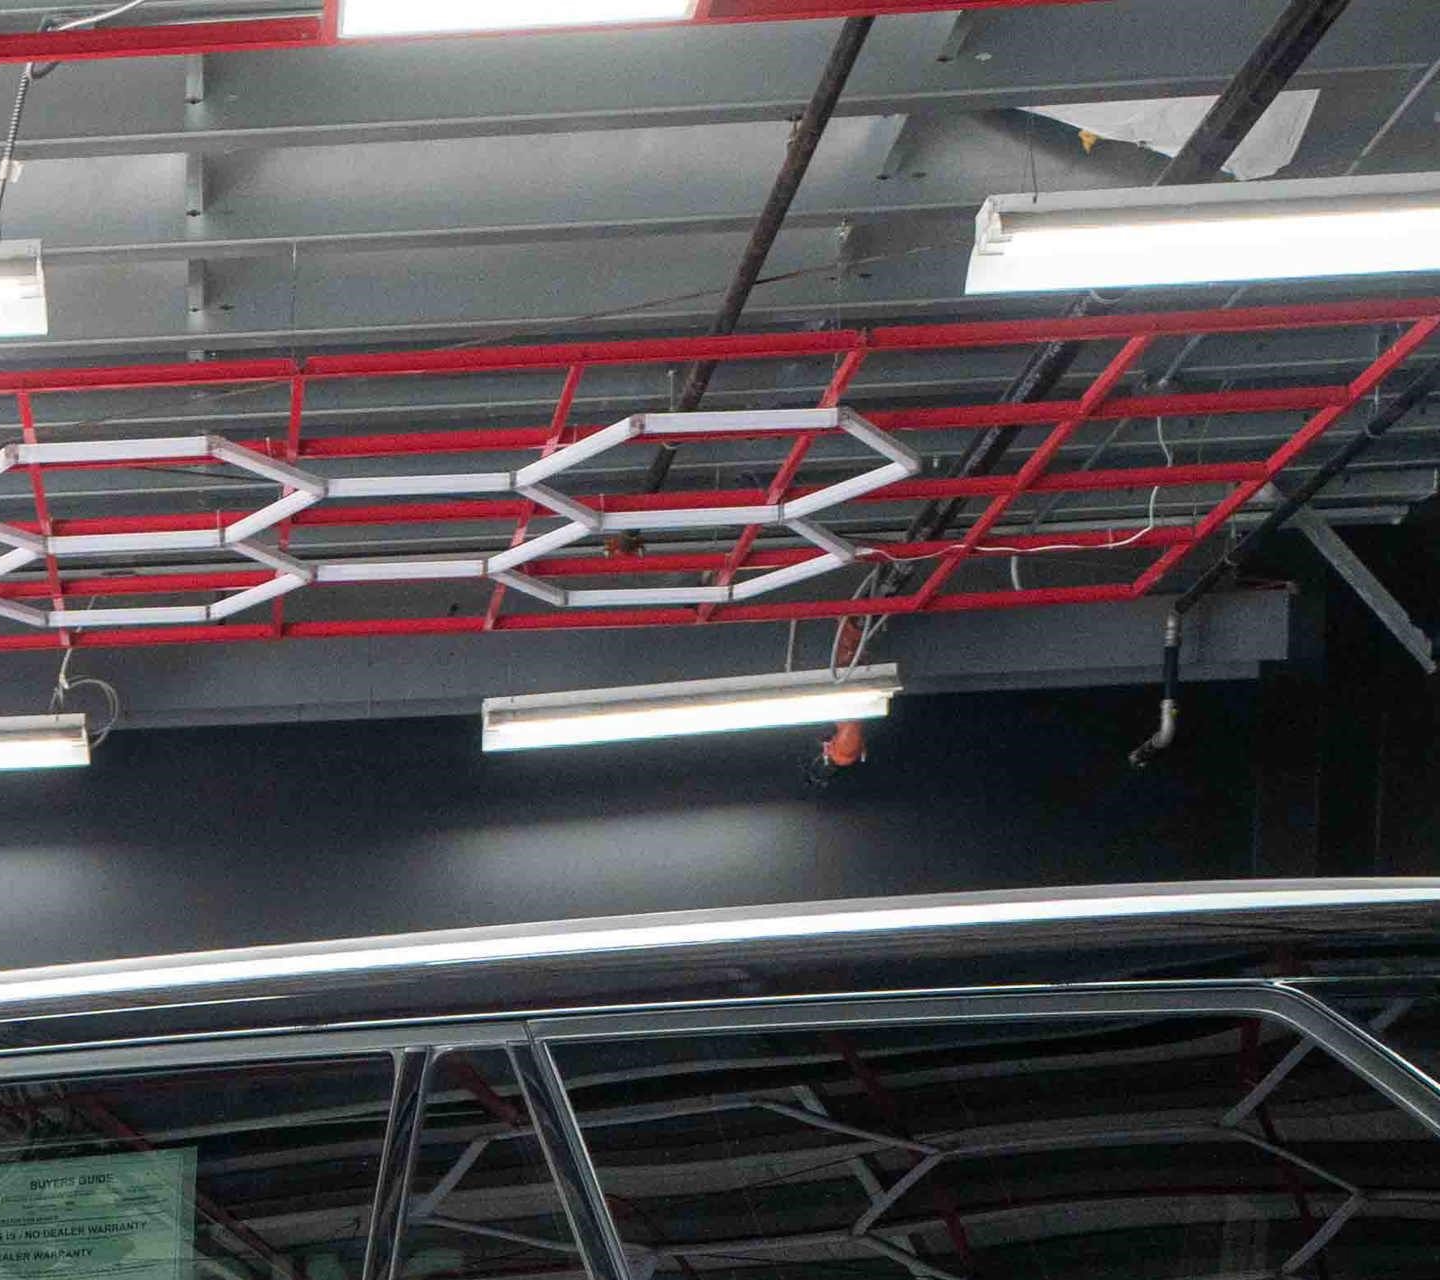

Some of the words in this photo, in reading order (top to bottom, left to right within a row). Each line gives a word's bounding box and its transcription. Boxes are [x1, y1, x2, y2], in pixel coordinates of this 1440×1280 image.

[28, 1176, 76, 1191] BUYERS
[78, 1173, 115, 1186] GUIDE
[5, 1230, 16, 1241] IS
[24, 1230, 41, 1241] NO
[43, 1226, 85, 1240] DEALER
[86, 1221, 148, 1236] WARRANTY
[32, 1248, 94, 1262] WARRANTY
